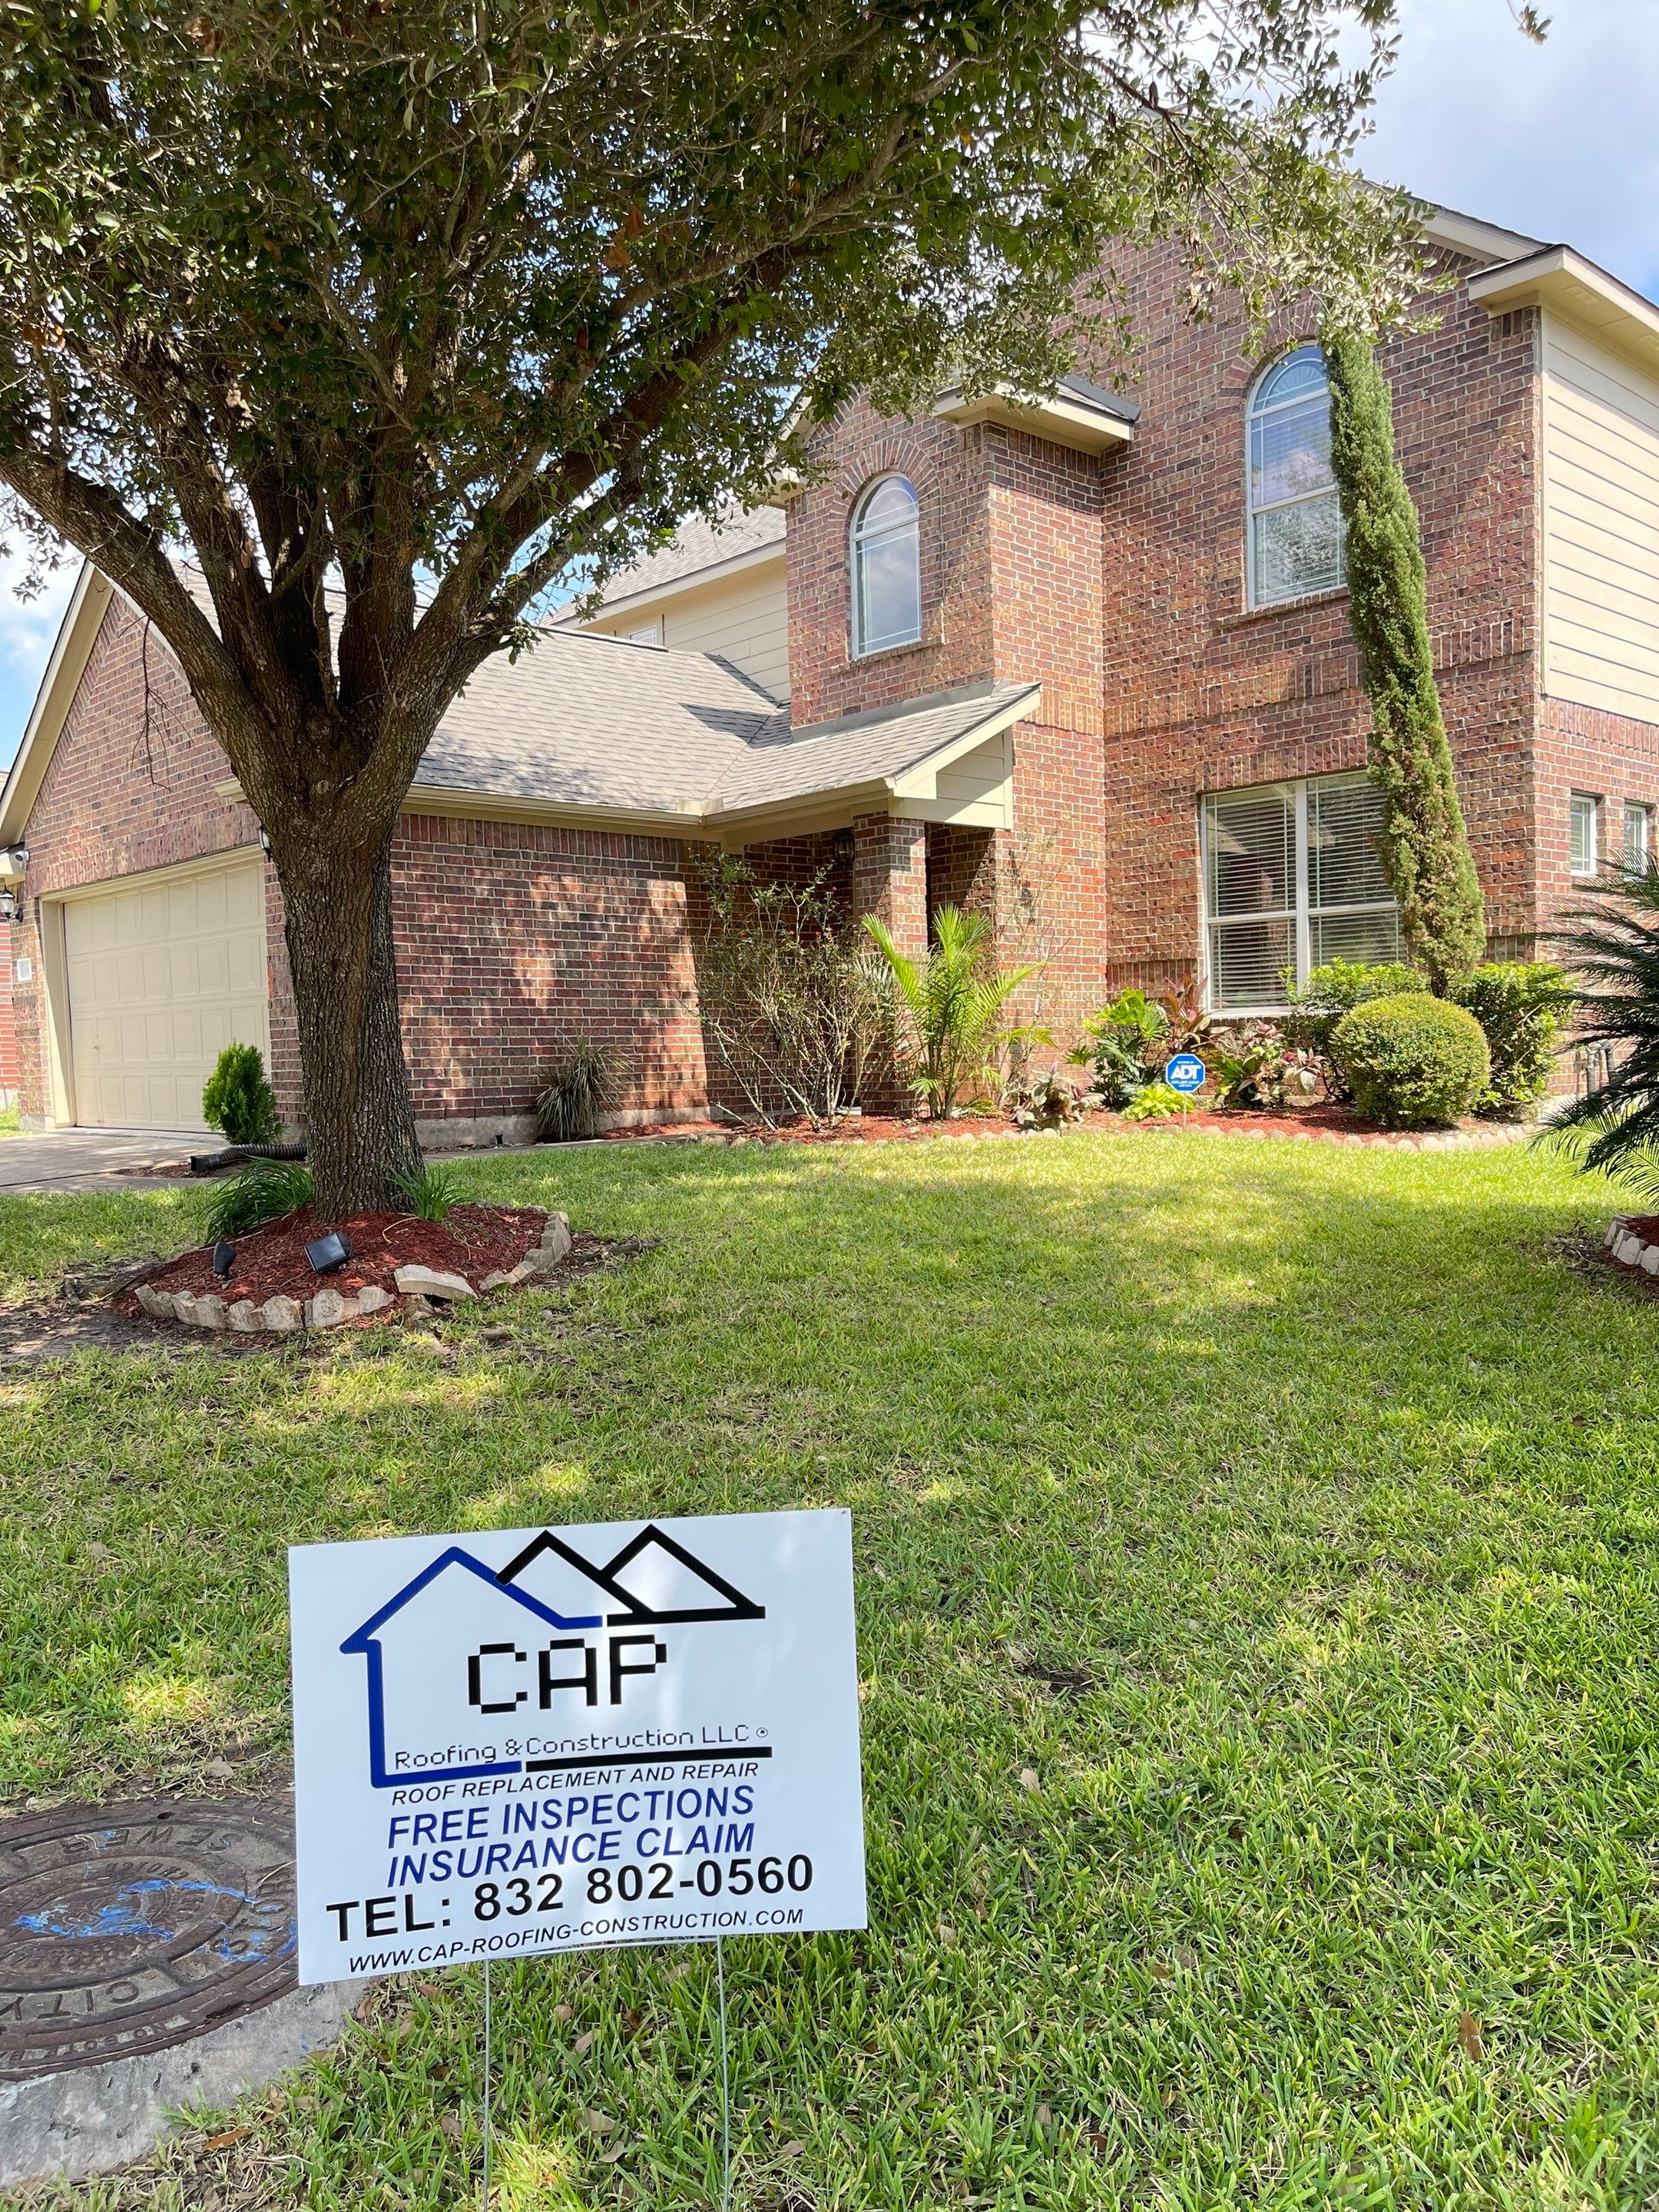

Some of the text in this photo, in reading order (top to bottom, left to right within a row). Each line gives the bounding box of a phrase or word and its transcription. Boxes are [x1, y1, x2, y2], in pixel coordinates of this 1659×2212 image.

[1171, 1065, 1201, 1080] ADT
[468, 1634, 667, 1714] CAP
[396, 1725, 749, 1770] Roofing & Construction LLC
[392, 1762, 758, 1806] ROOF REPLACEMENT AND REPAIR
[389, 1785, 754, 1849] FREE INSPECTIONS
[388, 1823, 754, 1888] INSURANCE CLAIM
[326, 1853, 813, 1942] TEL: 832 802-0560
[349, 1908, 803, 1972] WWW.CAP-ROOFING-CONSTRUCTION.COM
